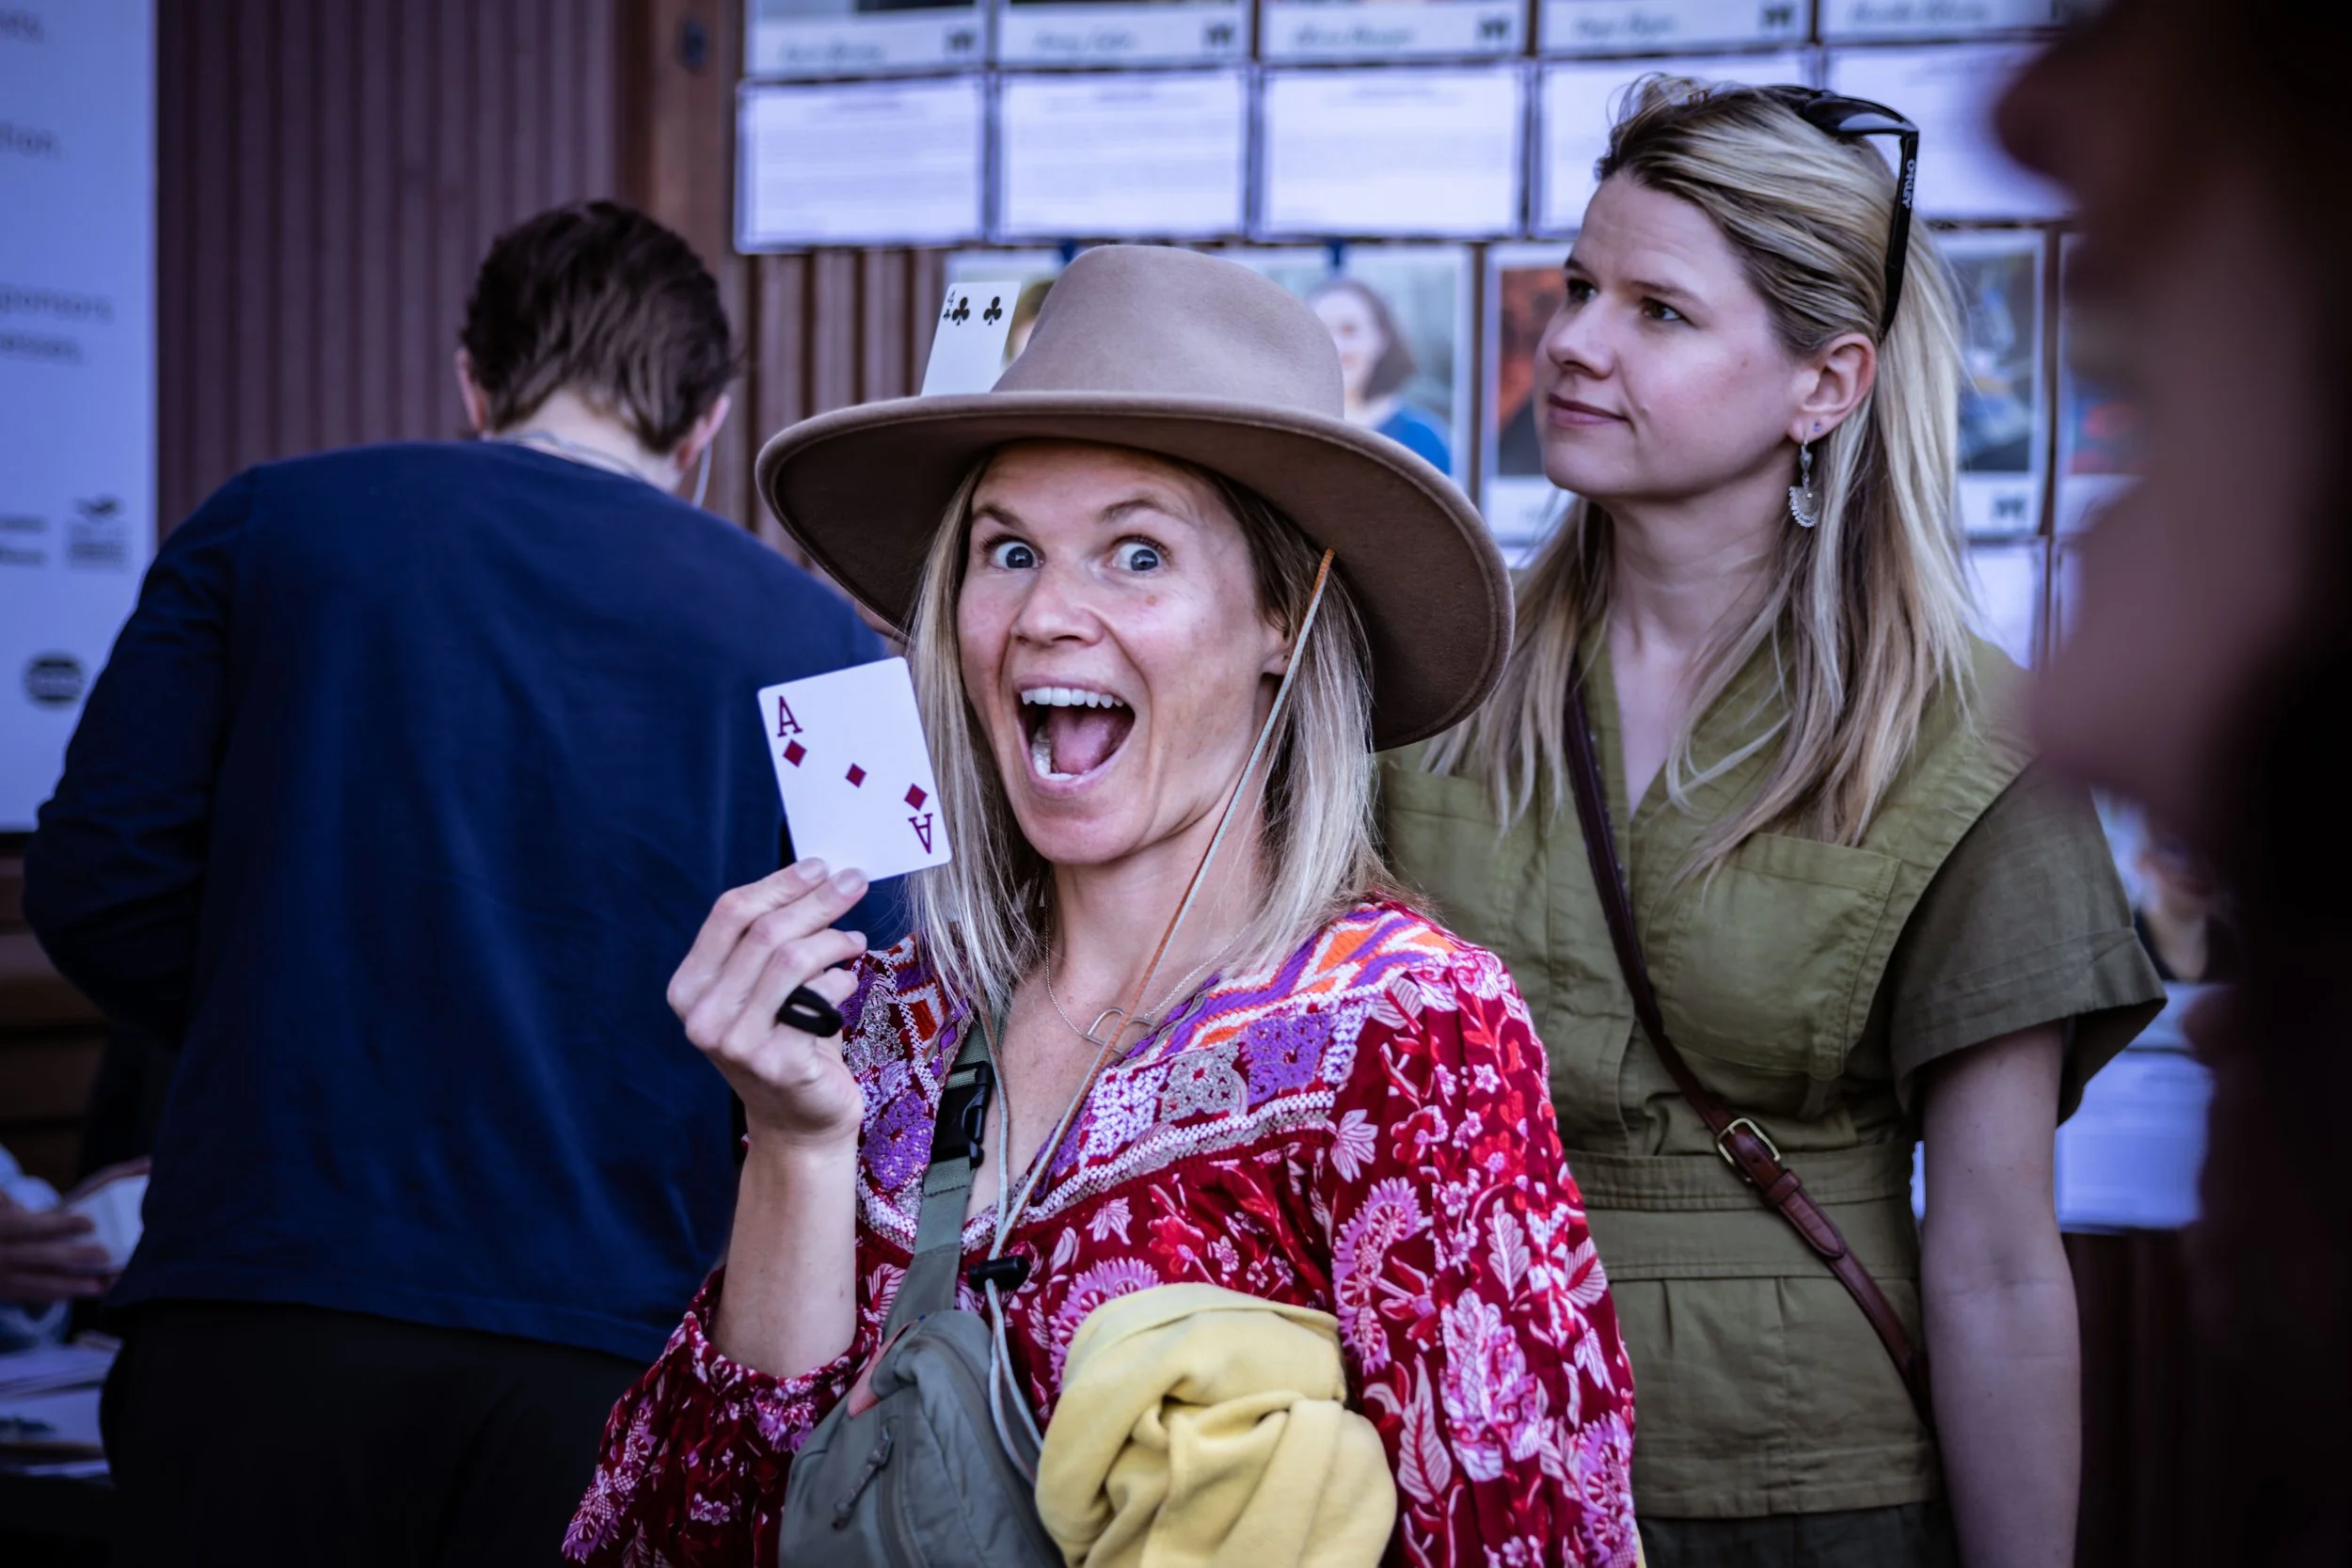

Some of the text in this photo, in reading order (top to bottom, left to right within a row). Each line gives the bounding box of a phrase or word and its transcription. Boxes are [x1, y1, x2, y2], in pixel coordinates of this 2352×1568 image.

[1901, 158, 1915, 209] OAKLEY
[777, 695, 803, 737] A
[908, 813, 933, 854] A
